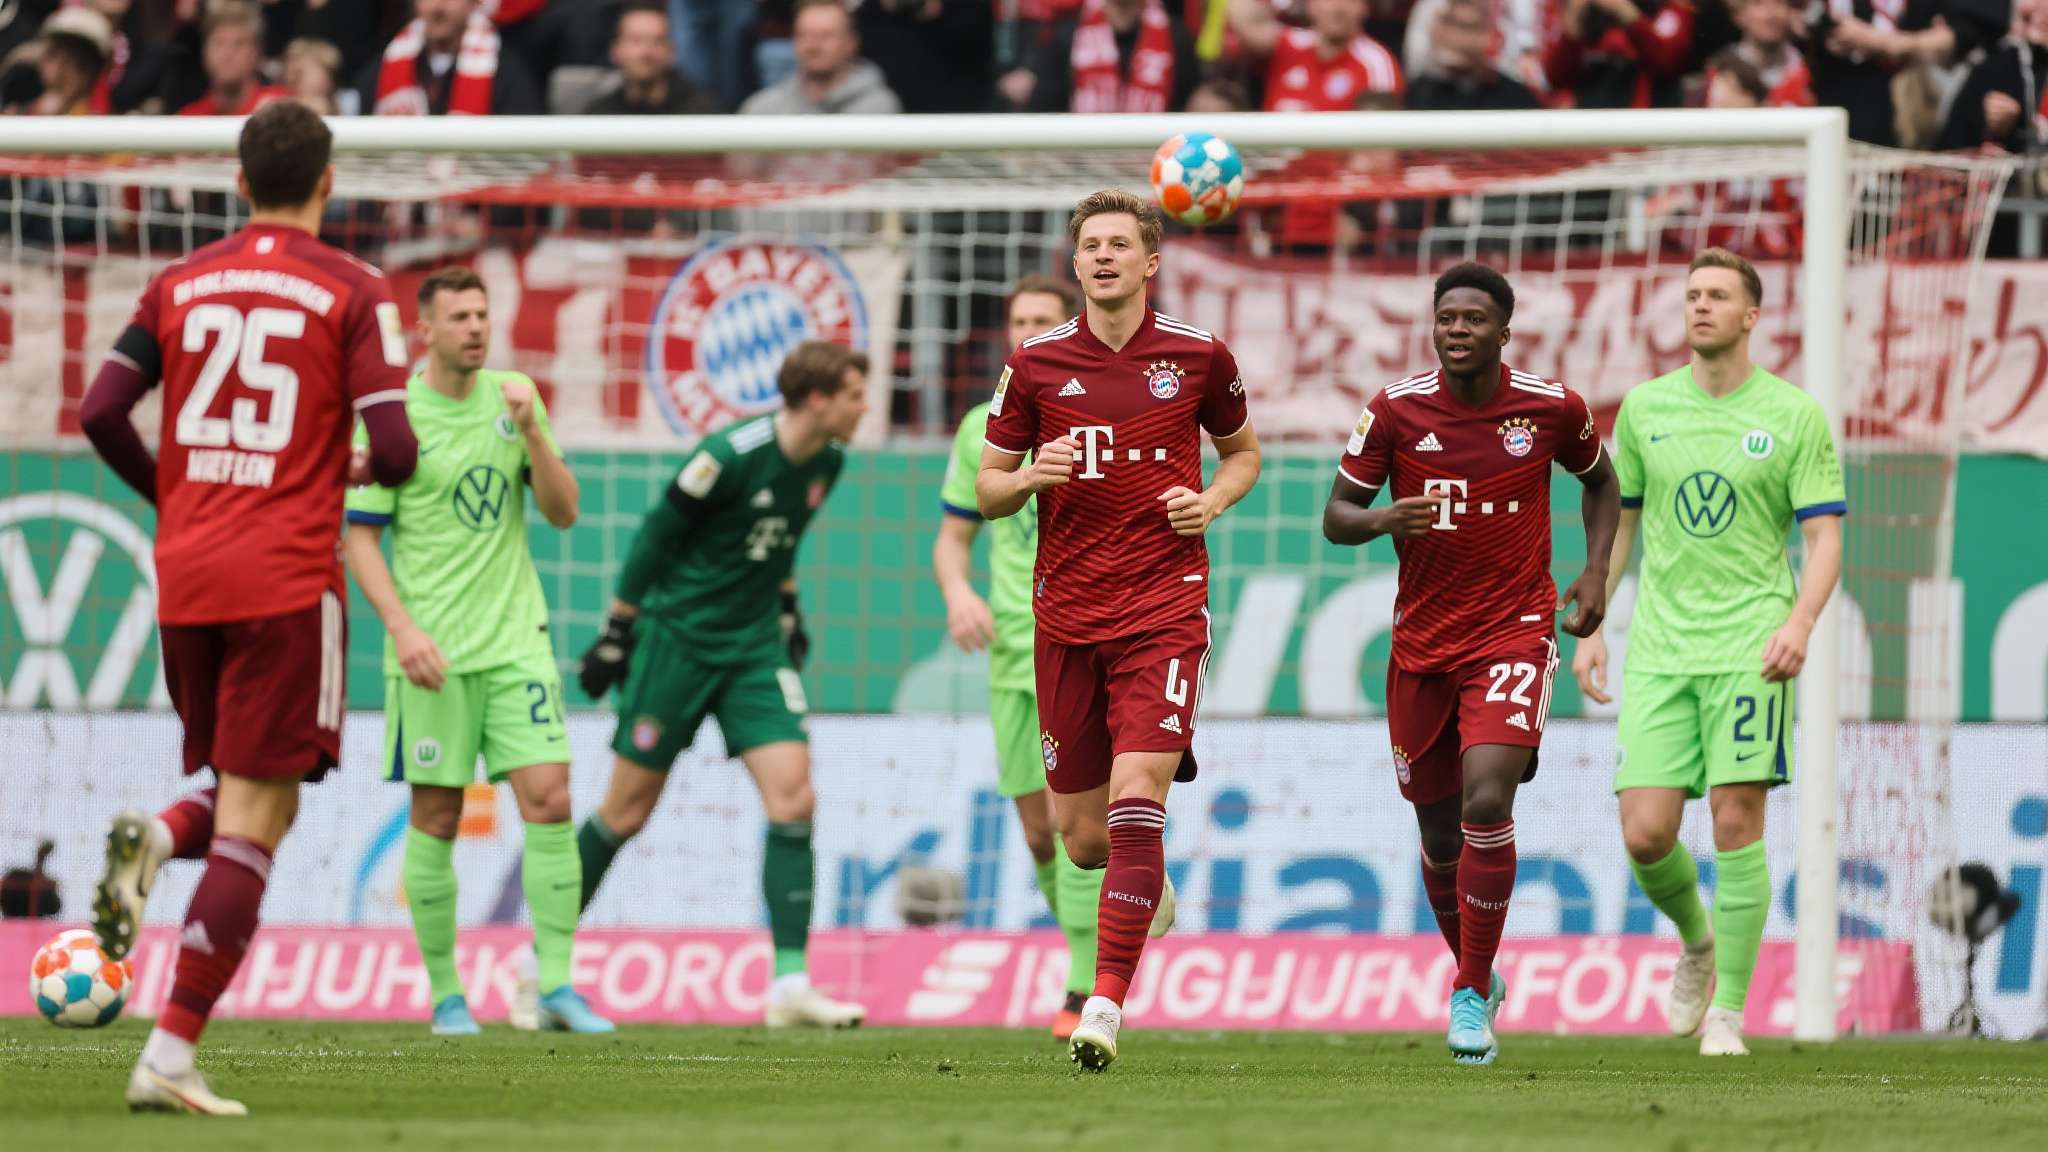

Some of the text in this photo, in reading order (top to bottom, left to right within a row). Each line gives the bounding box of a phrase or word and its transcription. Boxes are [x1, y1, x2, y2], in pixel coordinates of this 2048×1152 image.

[704, 247, 853, 328] BAYERN
[175, 303, 306, 453] 25
[1070, 425, 1114, 480] T
[1675, 471, 1736, 538] VW
[1165, 658, 1188, 707] 4
[1485, 661, 1537, 708] 22
[1734, 694, 1776, 742] 21
